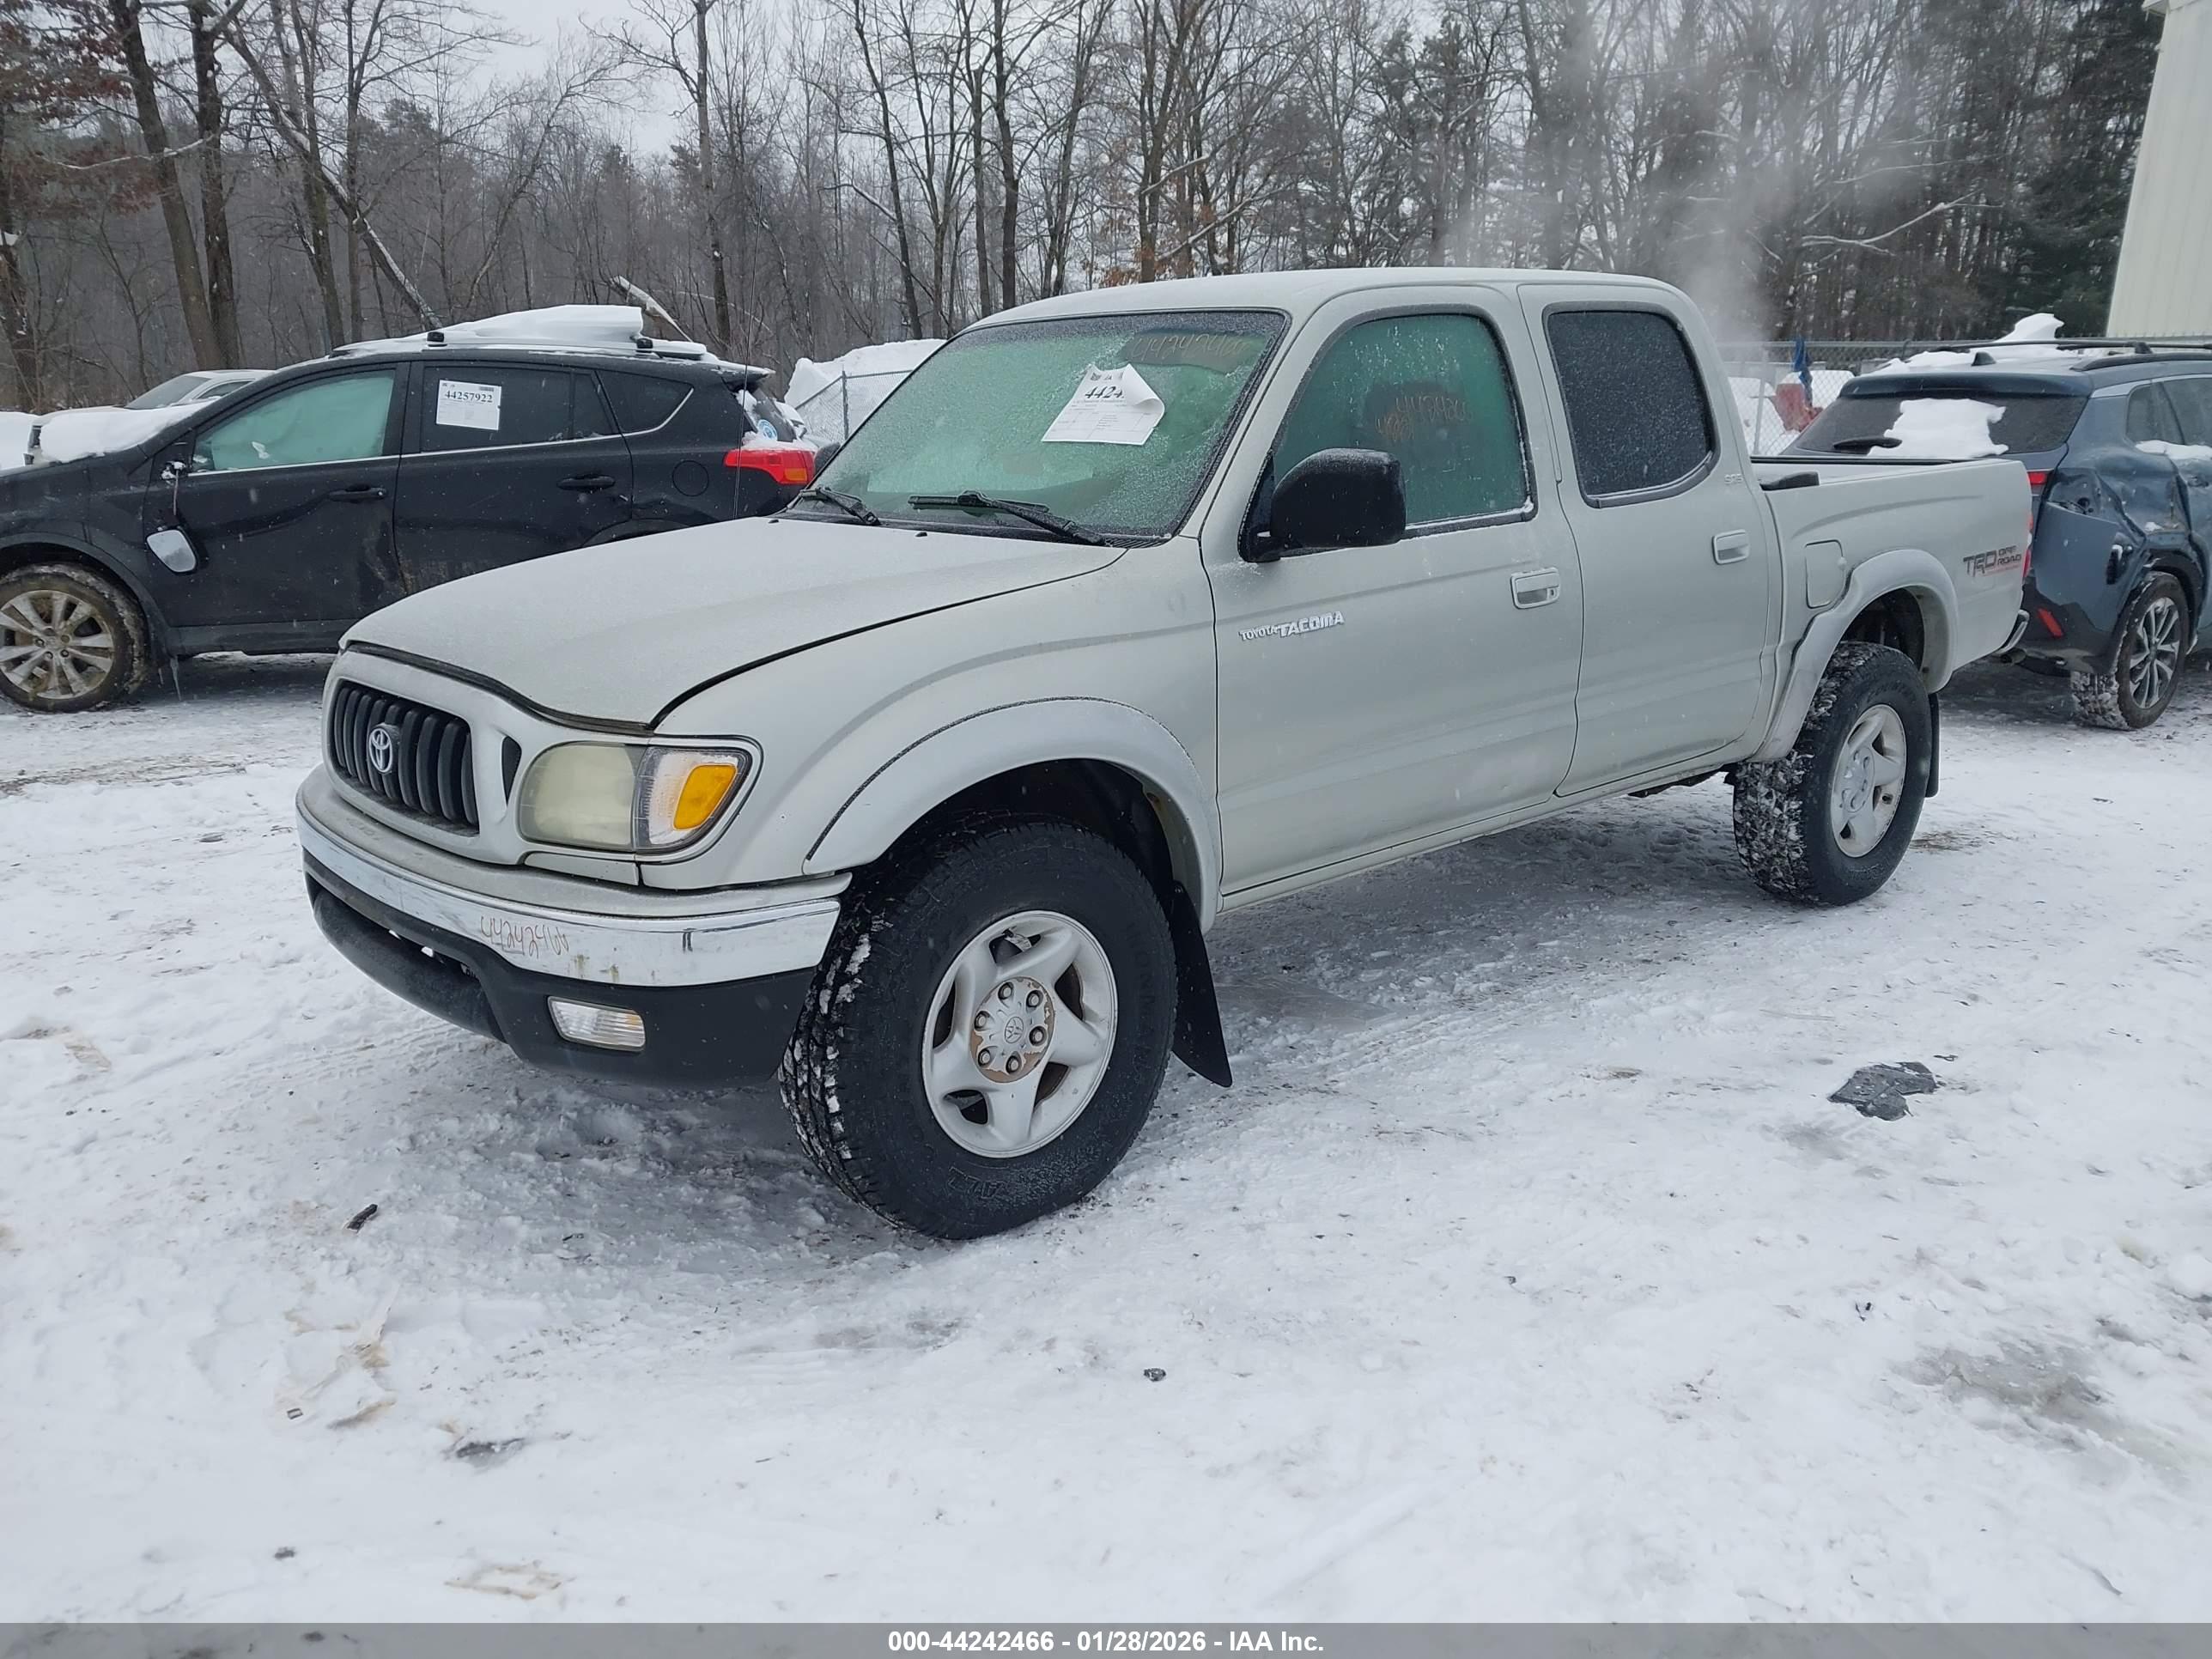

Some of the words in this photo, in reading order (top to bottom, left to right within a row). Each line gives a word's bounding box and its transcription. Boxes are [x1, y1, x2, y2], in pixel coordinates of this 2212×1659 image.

[445, 391, 493, 403] 44257922
[1085, 386, 1125, 398] 4424
[1963, 550, 1997, 577] TRD
[1997, 554, 2022, 565] ROAD
[1238, 625, 1279, 641] TOYOTA
[1277, 611, 1344, 638] TACOMA
[481, 916, 569, 959] 44242466
